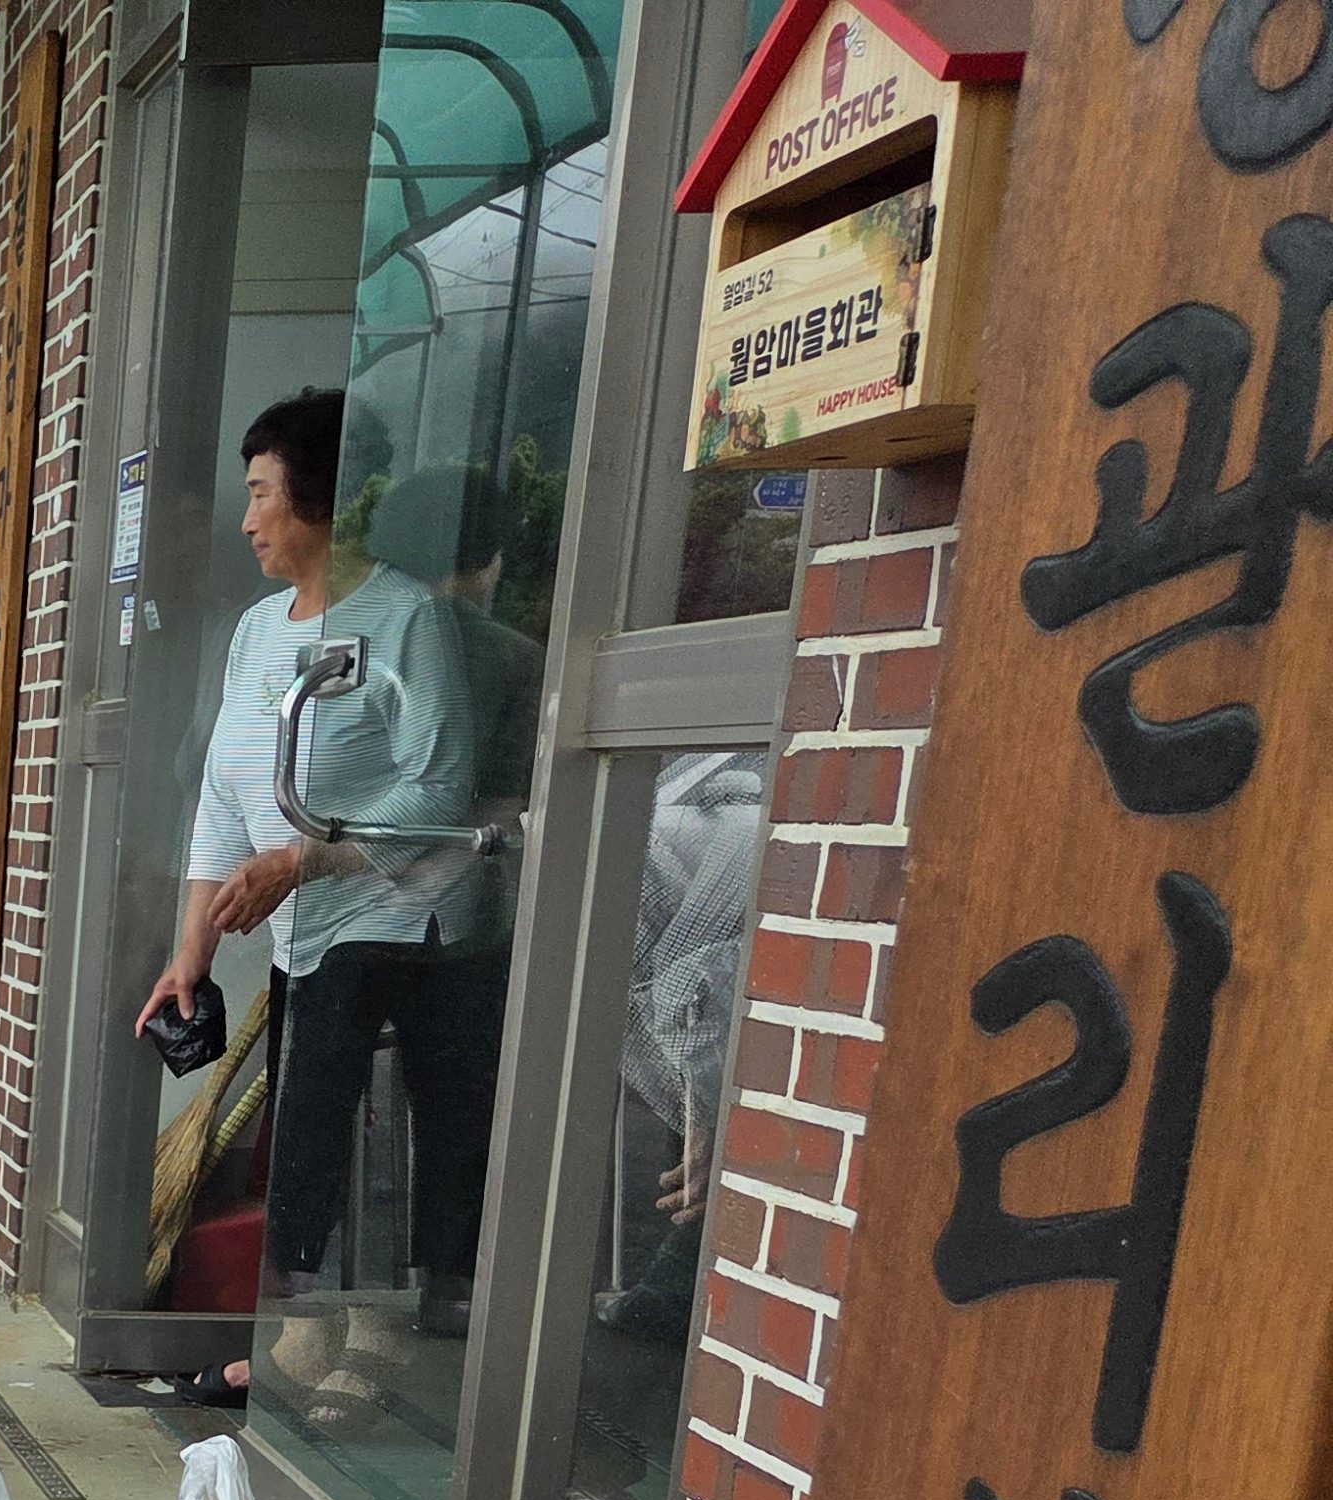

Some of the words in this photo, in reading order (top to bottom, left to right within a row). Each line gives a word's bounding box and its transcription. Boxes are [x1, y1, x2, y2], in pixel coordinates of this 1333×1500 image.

[765, 117, 820, 180] POST
[821, 75, 898, 151] OFFICE
[722, 274, 756, 312] 월암길
[757, 269, 774, 296] 52
[728, 284, 883, 387] 월암마을회관
[817, 388, 856, 417] HAPPY
[858, 375, 898, 402] HOUSE
